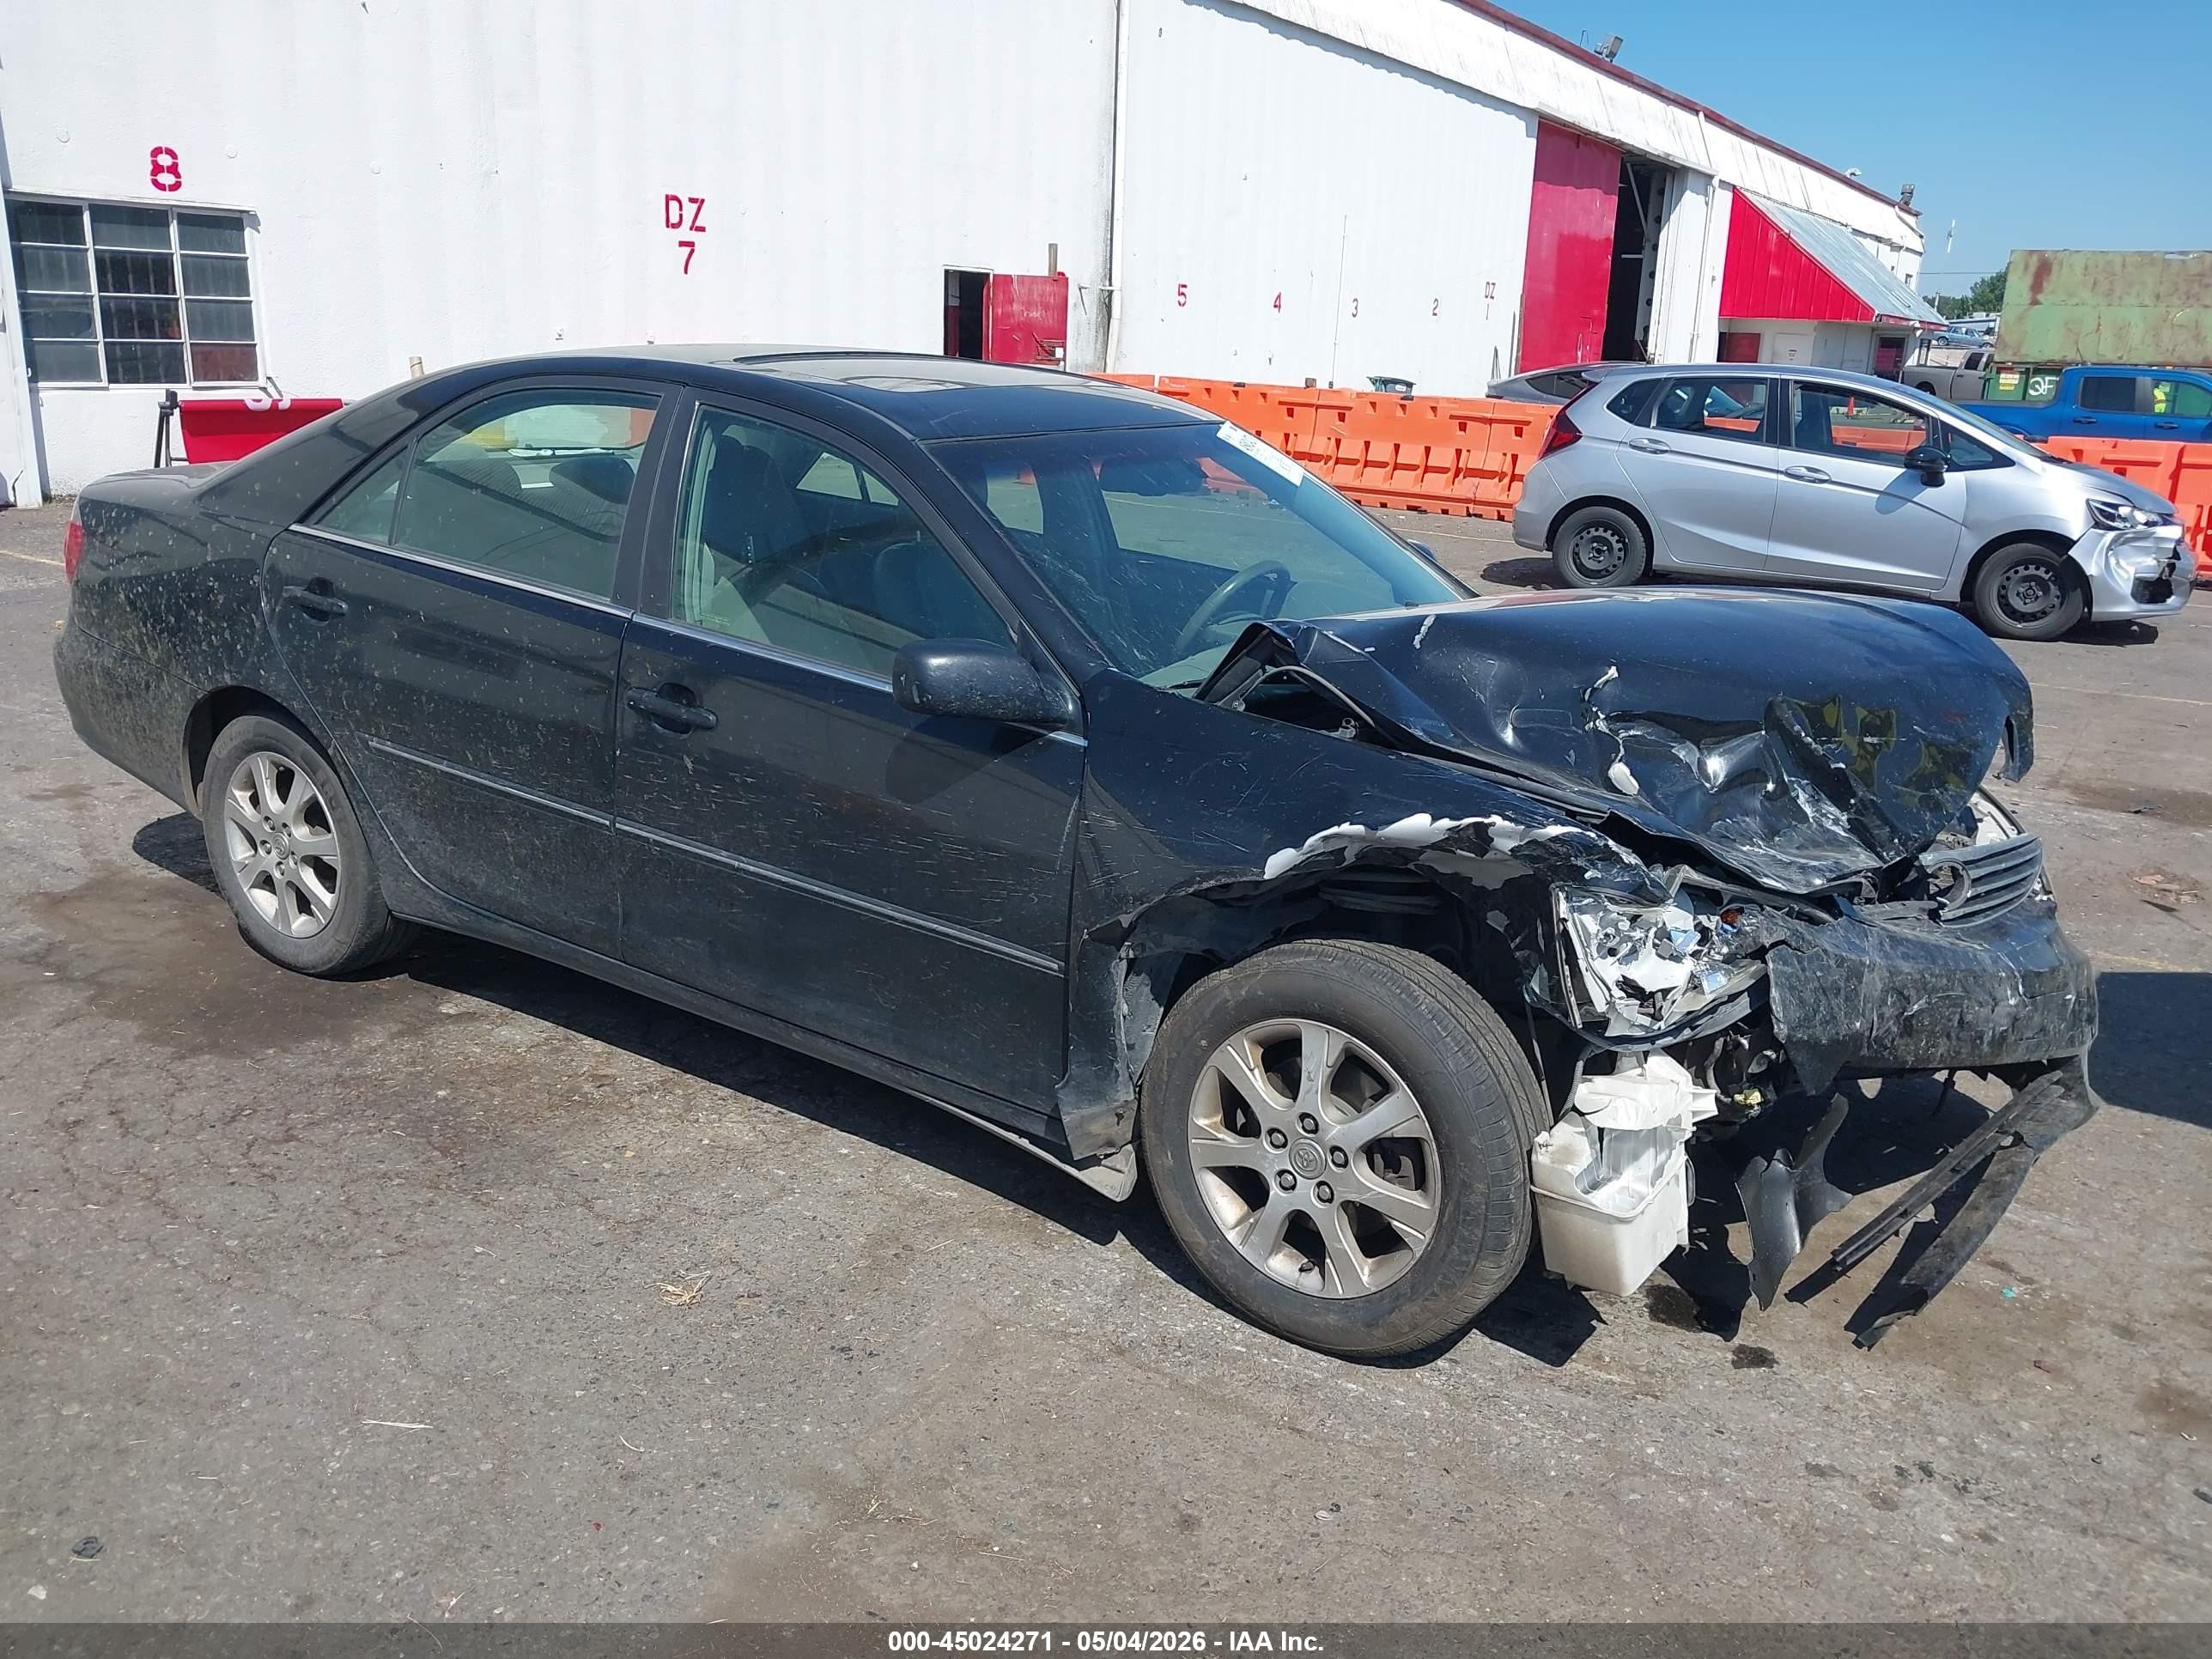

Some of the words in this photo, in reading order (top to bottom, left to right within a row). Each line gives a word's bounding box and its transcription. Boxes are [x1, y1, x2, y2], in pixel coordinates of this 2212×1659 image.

[149, 145, 183, 192] 8
[665, 193, 707, 233] DZ
[678, 240, 696, 275] 7
[1177, 283, 1188, 307] 5
[1273, 291, 1282, 313] 4
[1485, 281, 1497, 301] DZ
[1352, 297, 1358, 318] 3
[1431, 297, 1439, 317] 2
